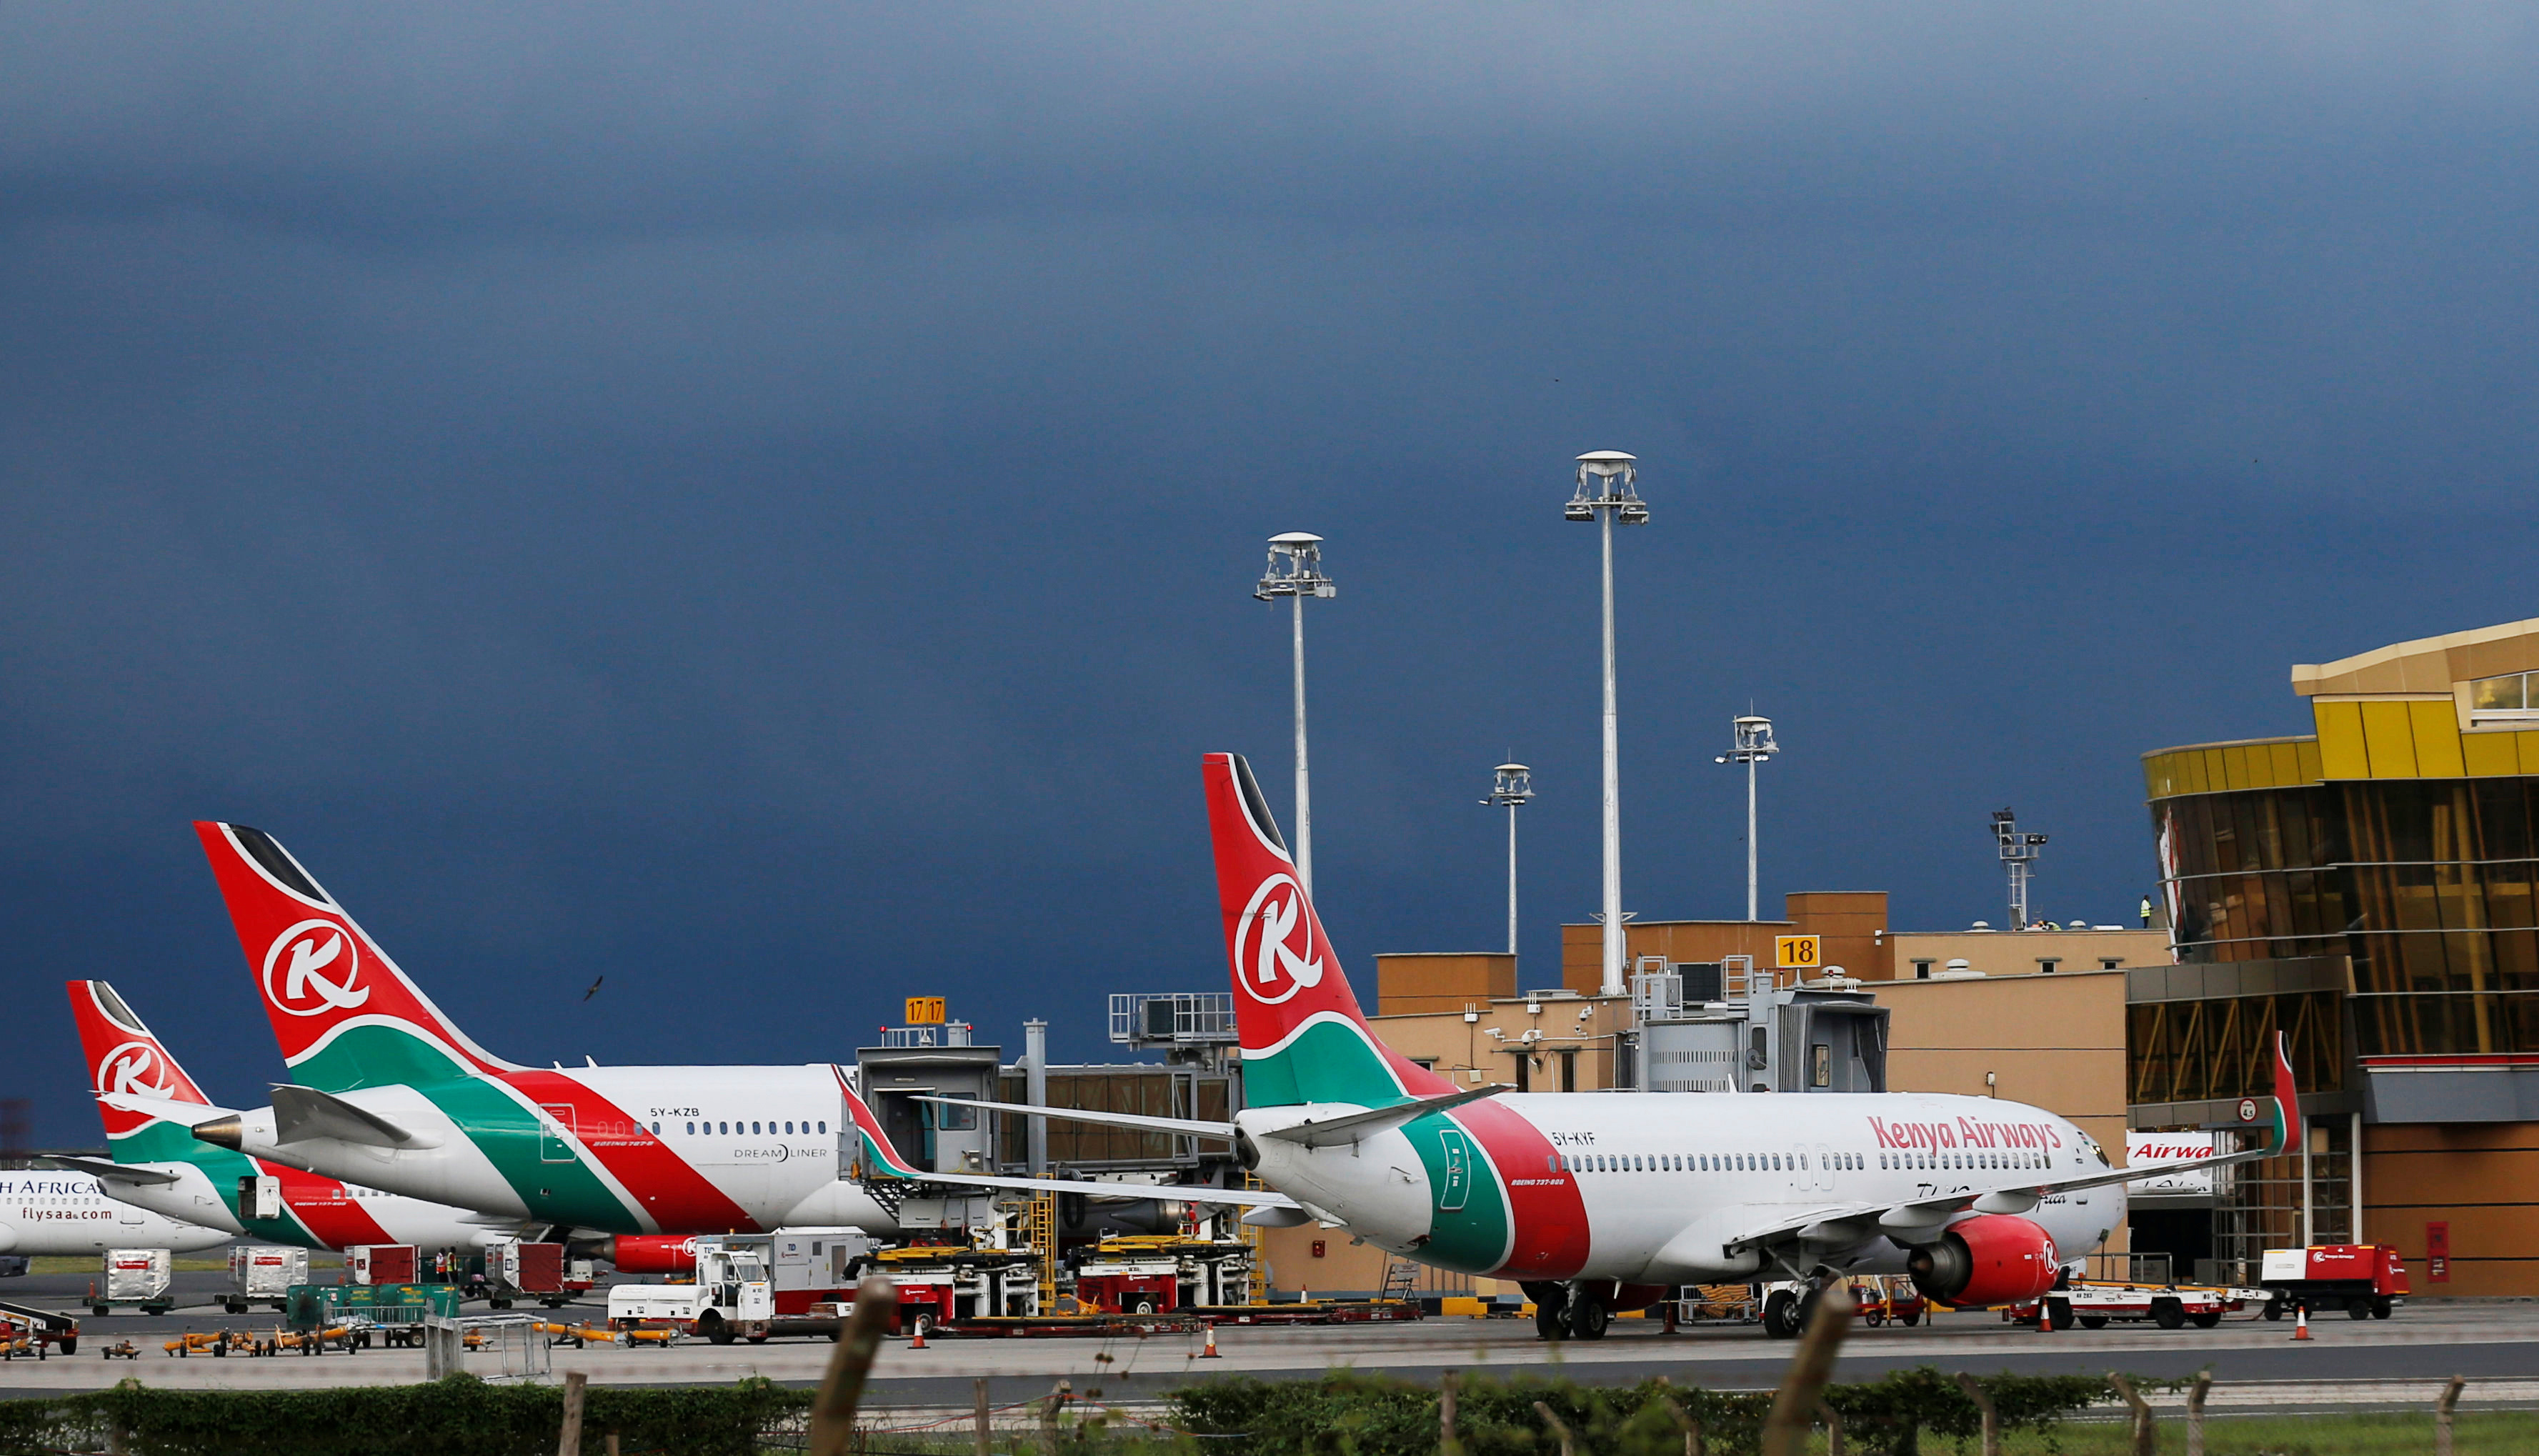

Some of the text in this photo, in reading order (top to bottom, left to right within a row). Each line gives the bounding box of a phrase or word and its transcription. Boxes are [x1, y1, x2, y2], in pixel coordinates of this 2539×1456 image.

[1782, 939, 1814, 963] 18
[908, 1000, 923, 1021] 17
[929, 1000, 943, 1021] 17
[650, 1107, 700, 1117] 5Y-KZB
[1551, 1132, 1595, 1146] 5Y-KYF
[1866, 1115, 2062, 1158] Kenya Airways
[20, 1180, 99, 1195] AFRICA
[22, 1207, 112, 1222] flysaa.com
